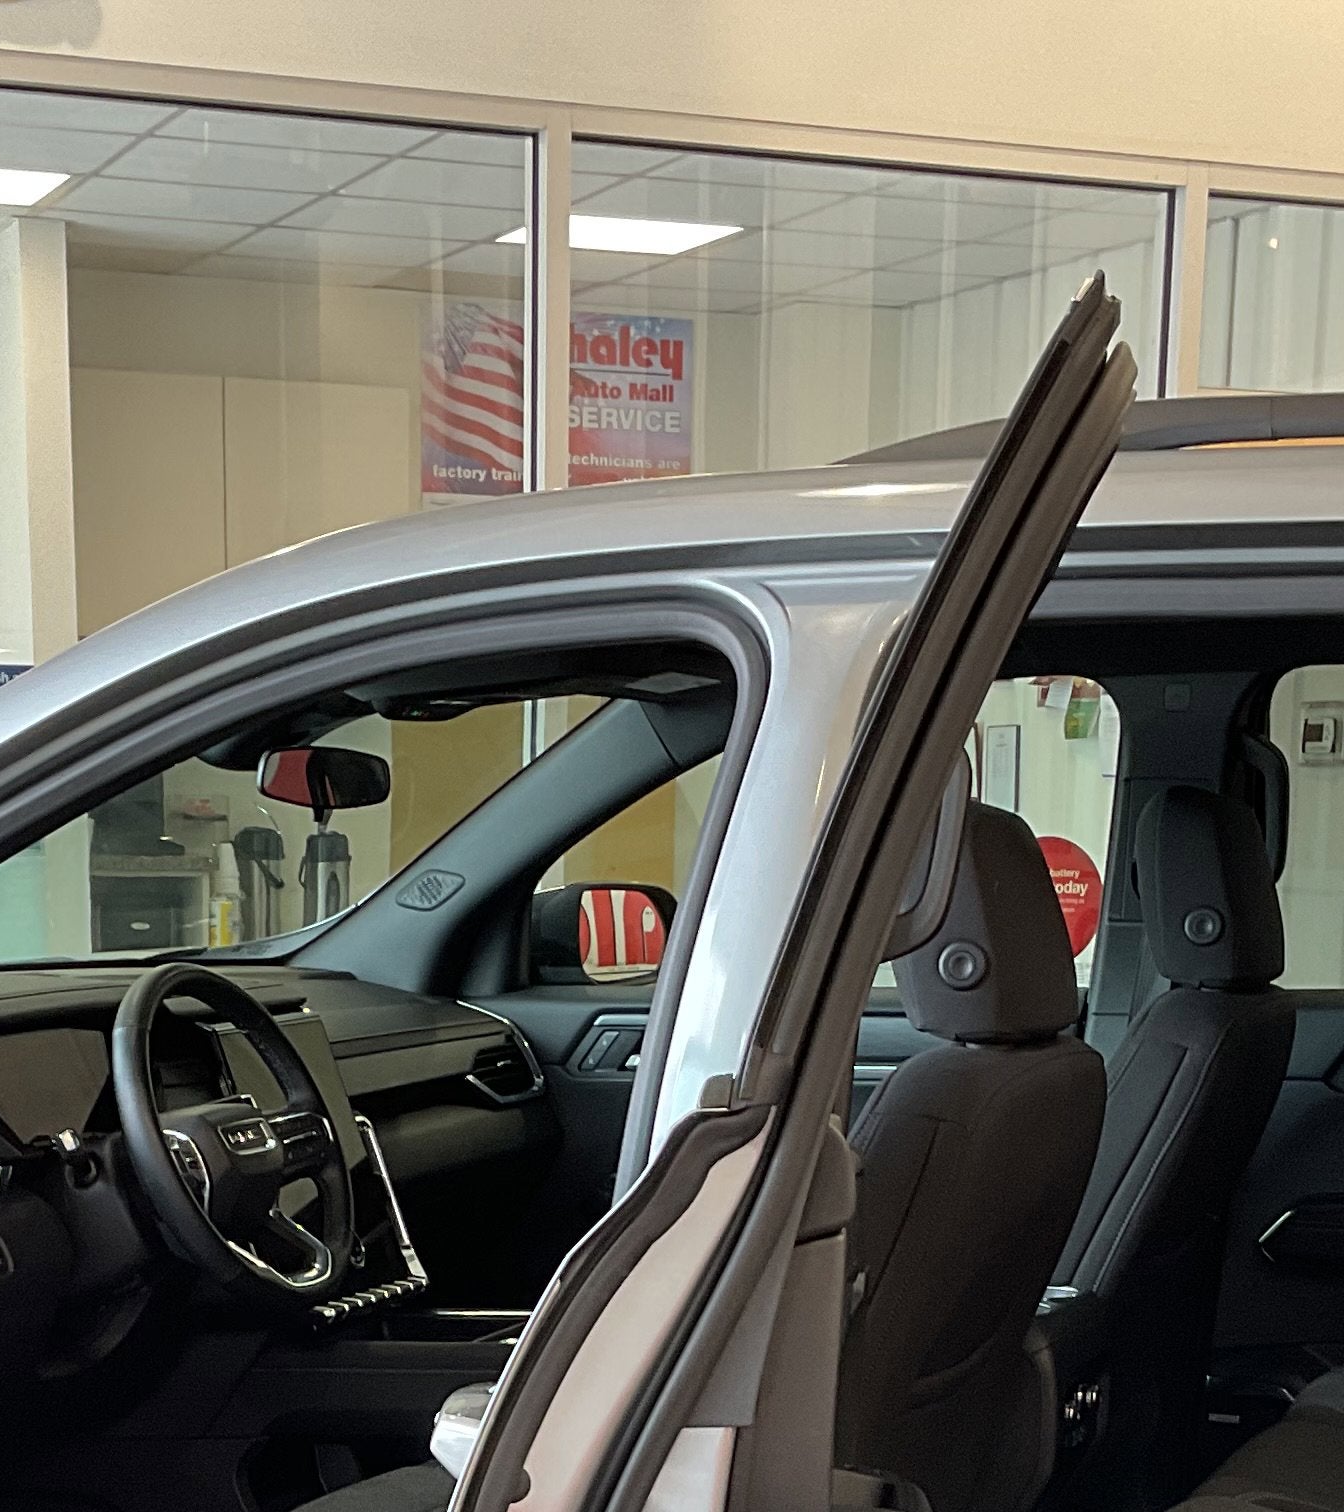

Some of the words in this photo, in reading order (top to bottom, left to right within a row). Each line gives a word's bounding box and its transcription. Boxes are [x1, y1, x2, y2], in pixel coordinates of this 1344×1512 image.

[569, 322, 684, 381] haley
[628, 382, 674, 403] Mall
[569, 405, 681, 433] SERVICE
[432, 464, 487, 483] factory
[568, 453, 654, 470] technicians
[658, 459, 681, 470] are
[1055, 880, 1089, 897] oday
